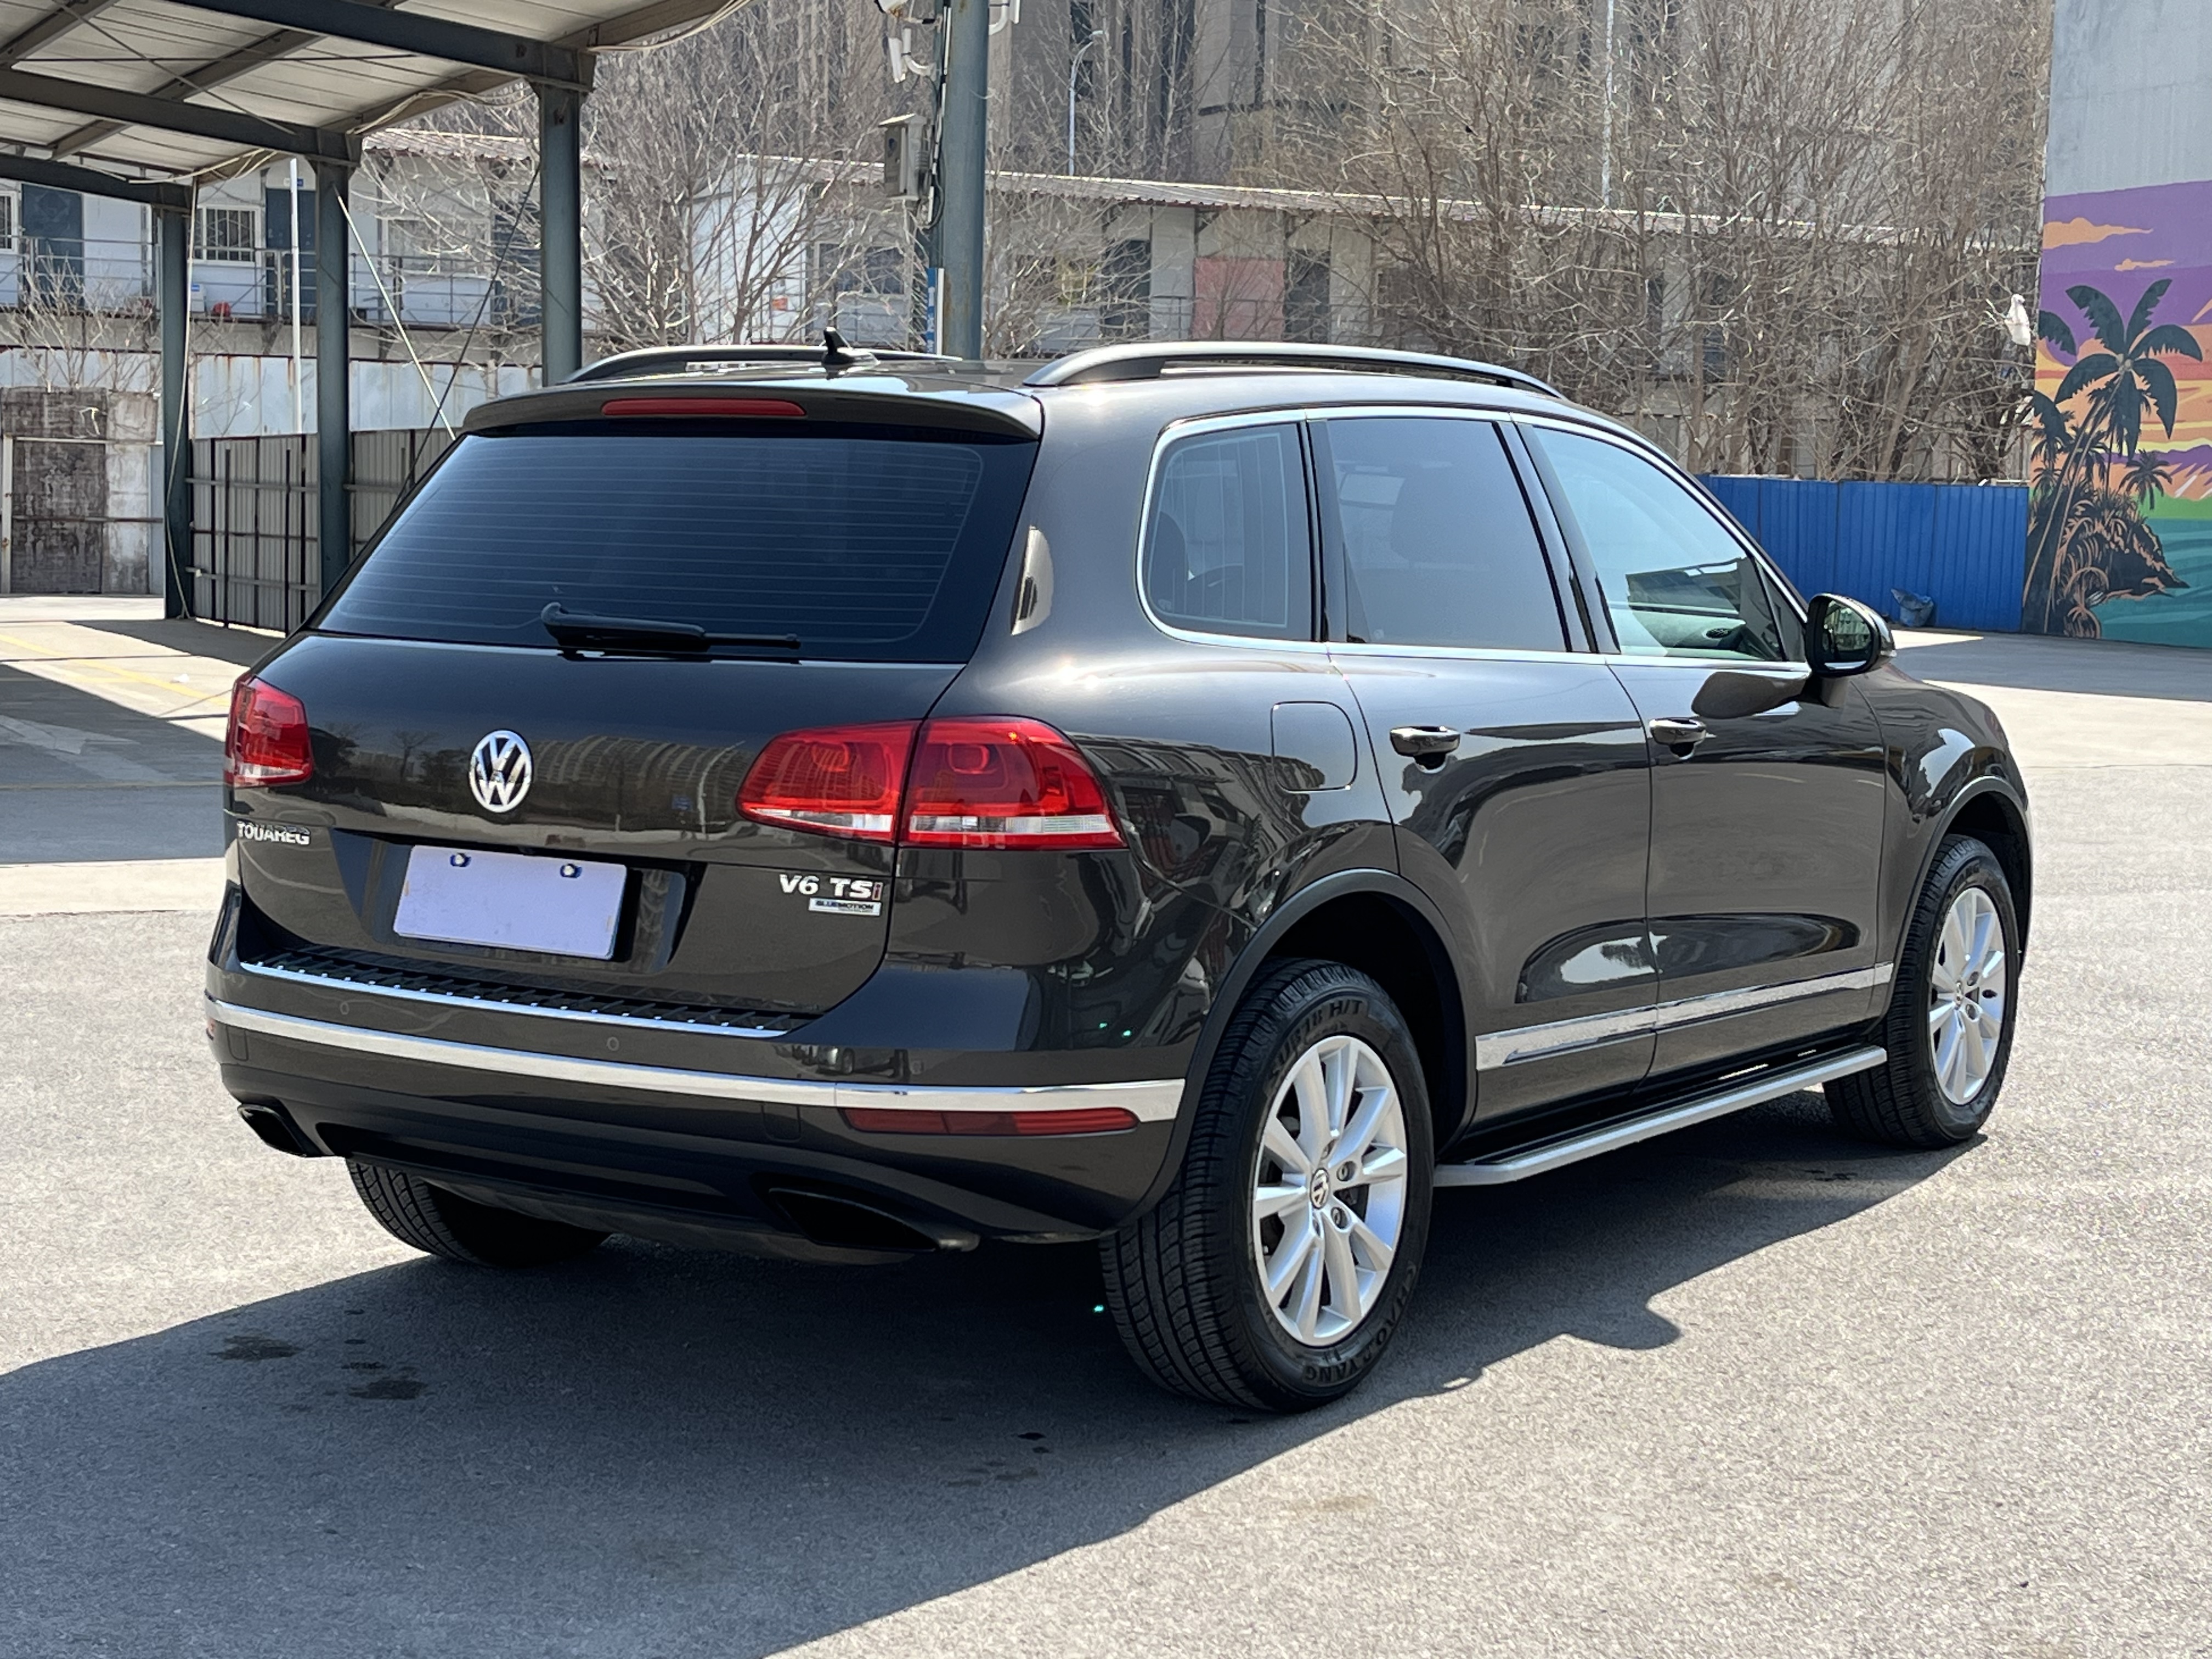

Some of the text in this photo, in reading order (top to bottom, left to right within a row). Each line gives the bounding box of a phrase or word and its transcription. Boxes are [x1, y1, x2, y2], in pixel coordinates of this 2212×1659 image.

[469, 730, 532, 813] VW
[237, 822, 310, 845] TOUAREG
[779, 874, 820, 895] V6
[1329, 1000, 1363, 1018] H/T
